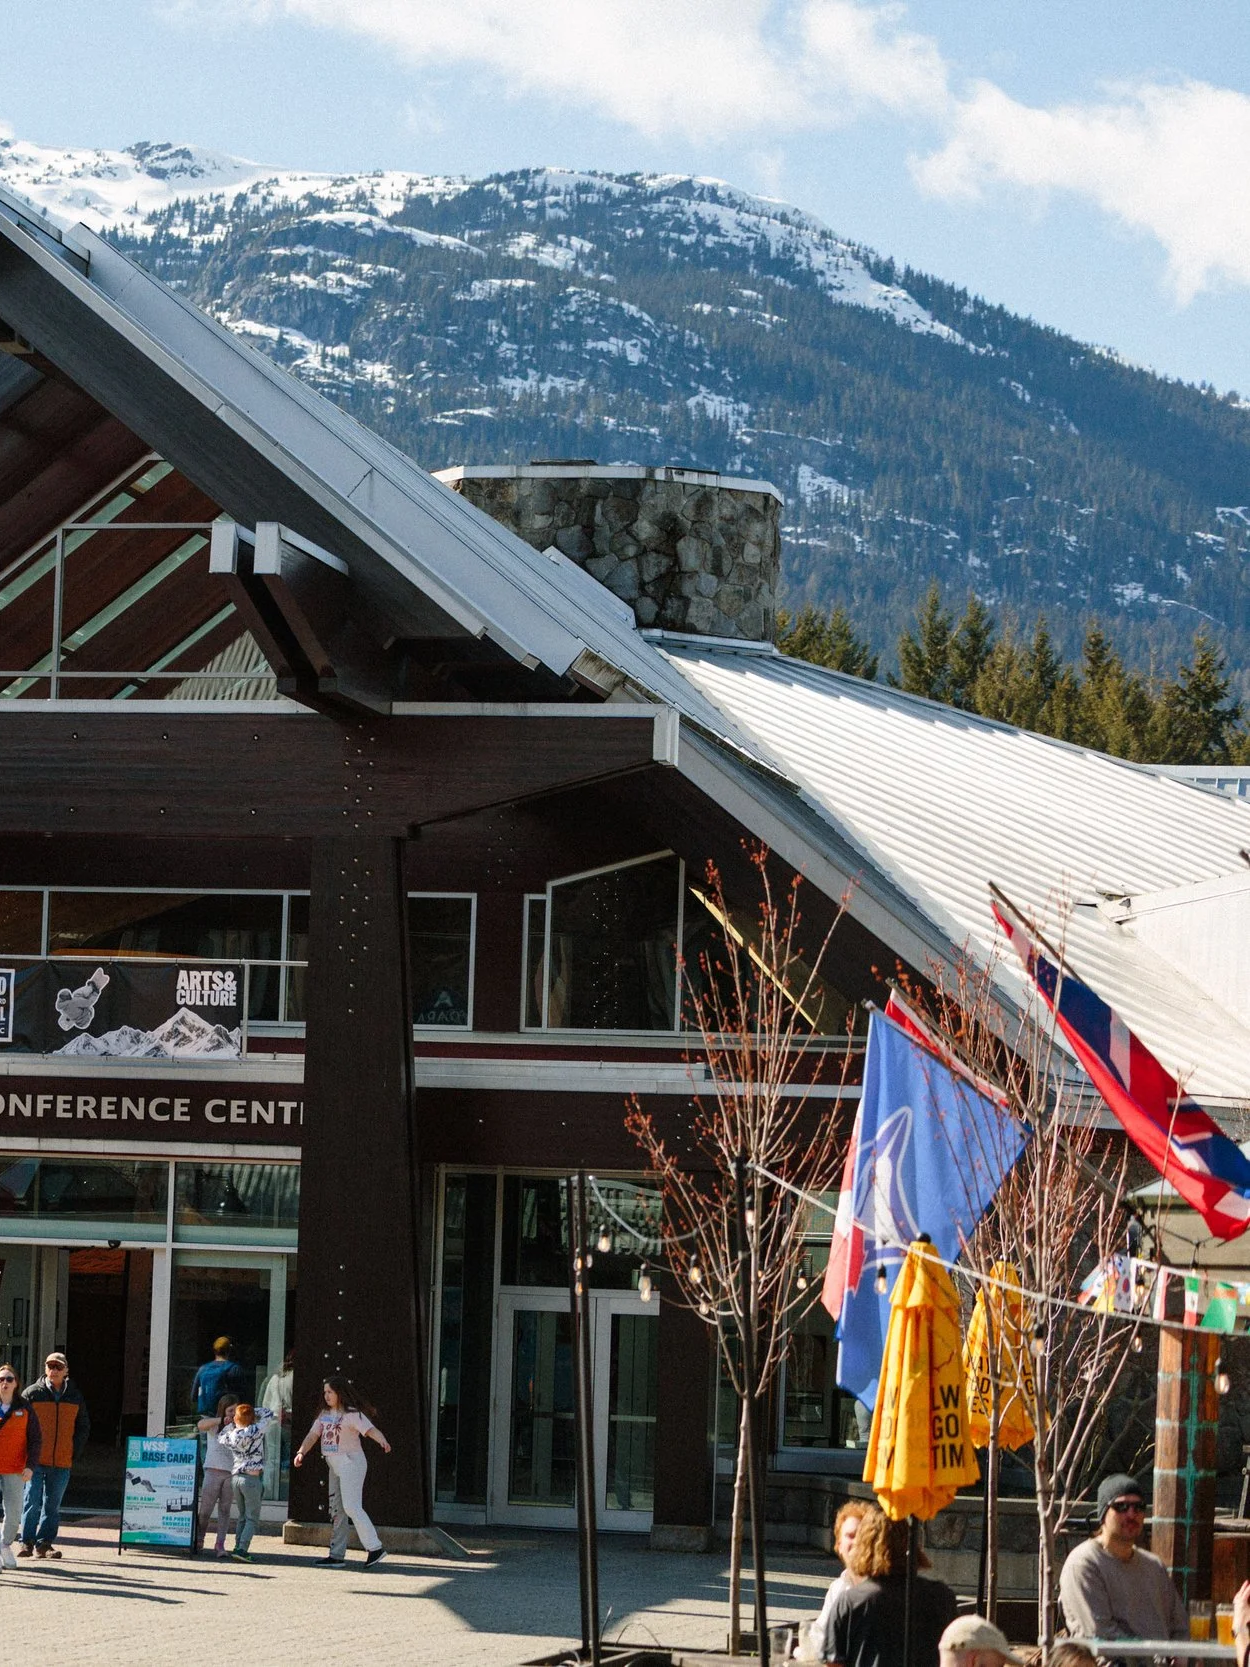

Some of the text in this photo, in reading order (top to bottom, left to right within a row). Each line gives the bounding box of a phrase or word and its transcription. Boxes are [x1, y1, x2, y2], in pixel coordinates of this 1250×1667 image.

[176, 970, 237, 991] ARTS&
[176, 989, 237, 1006] CULTURE
[204, 1099, 303, 1125] CENT
[142, 1440, 169, 1451] WSSF
[142, 1451, 165, 1463] BASE
[167, 1453, 194, 1464] CAMP
